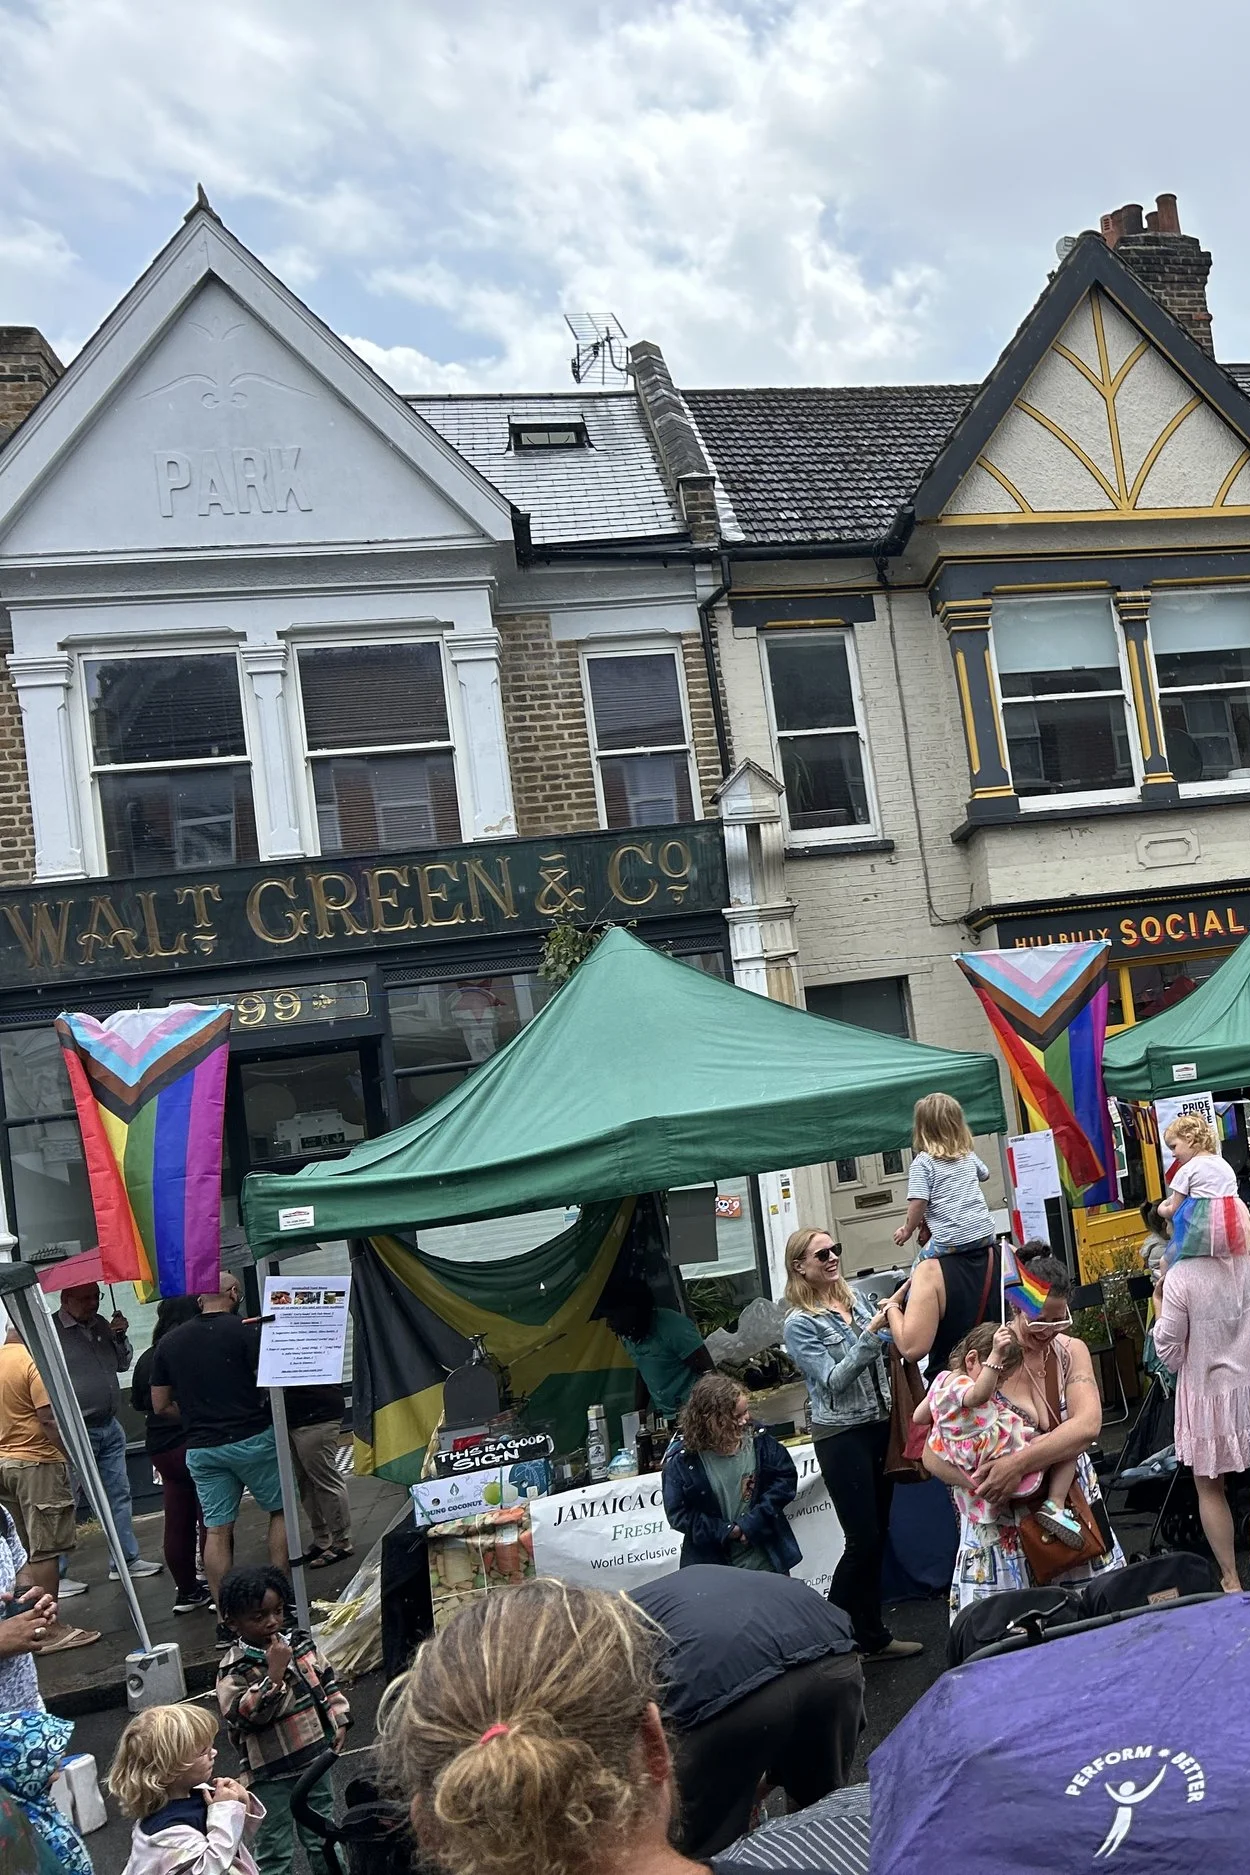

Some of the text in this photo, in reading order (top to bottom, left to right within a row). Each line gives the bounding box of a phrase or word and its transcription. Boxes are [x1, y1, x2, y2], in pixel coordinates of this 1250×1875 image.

[153, 445, 313, 518] PARK
[246, 856, 519, 943] GREEN
[1120, 907, 1247, 947] SOCIAL
[238, 990, 301, 1025] 99
[1182, 1100, 1211, 1112] PRIDE
[437, 1435, 545, 1463] THIS IS A GOOD
[452, 1449, 520, 1470] SIGN
[448, 1500, 482, 1512] COCONUT
[554, 1493, 646, 1527] JAMAICA
[796, 1500, 832, 1518] Munch
[591, 1546, 678, 1570] World Exclusive
[1065, 1745, 1205, 1803] PERFORM BETTER
